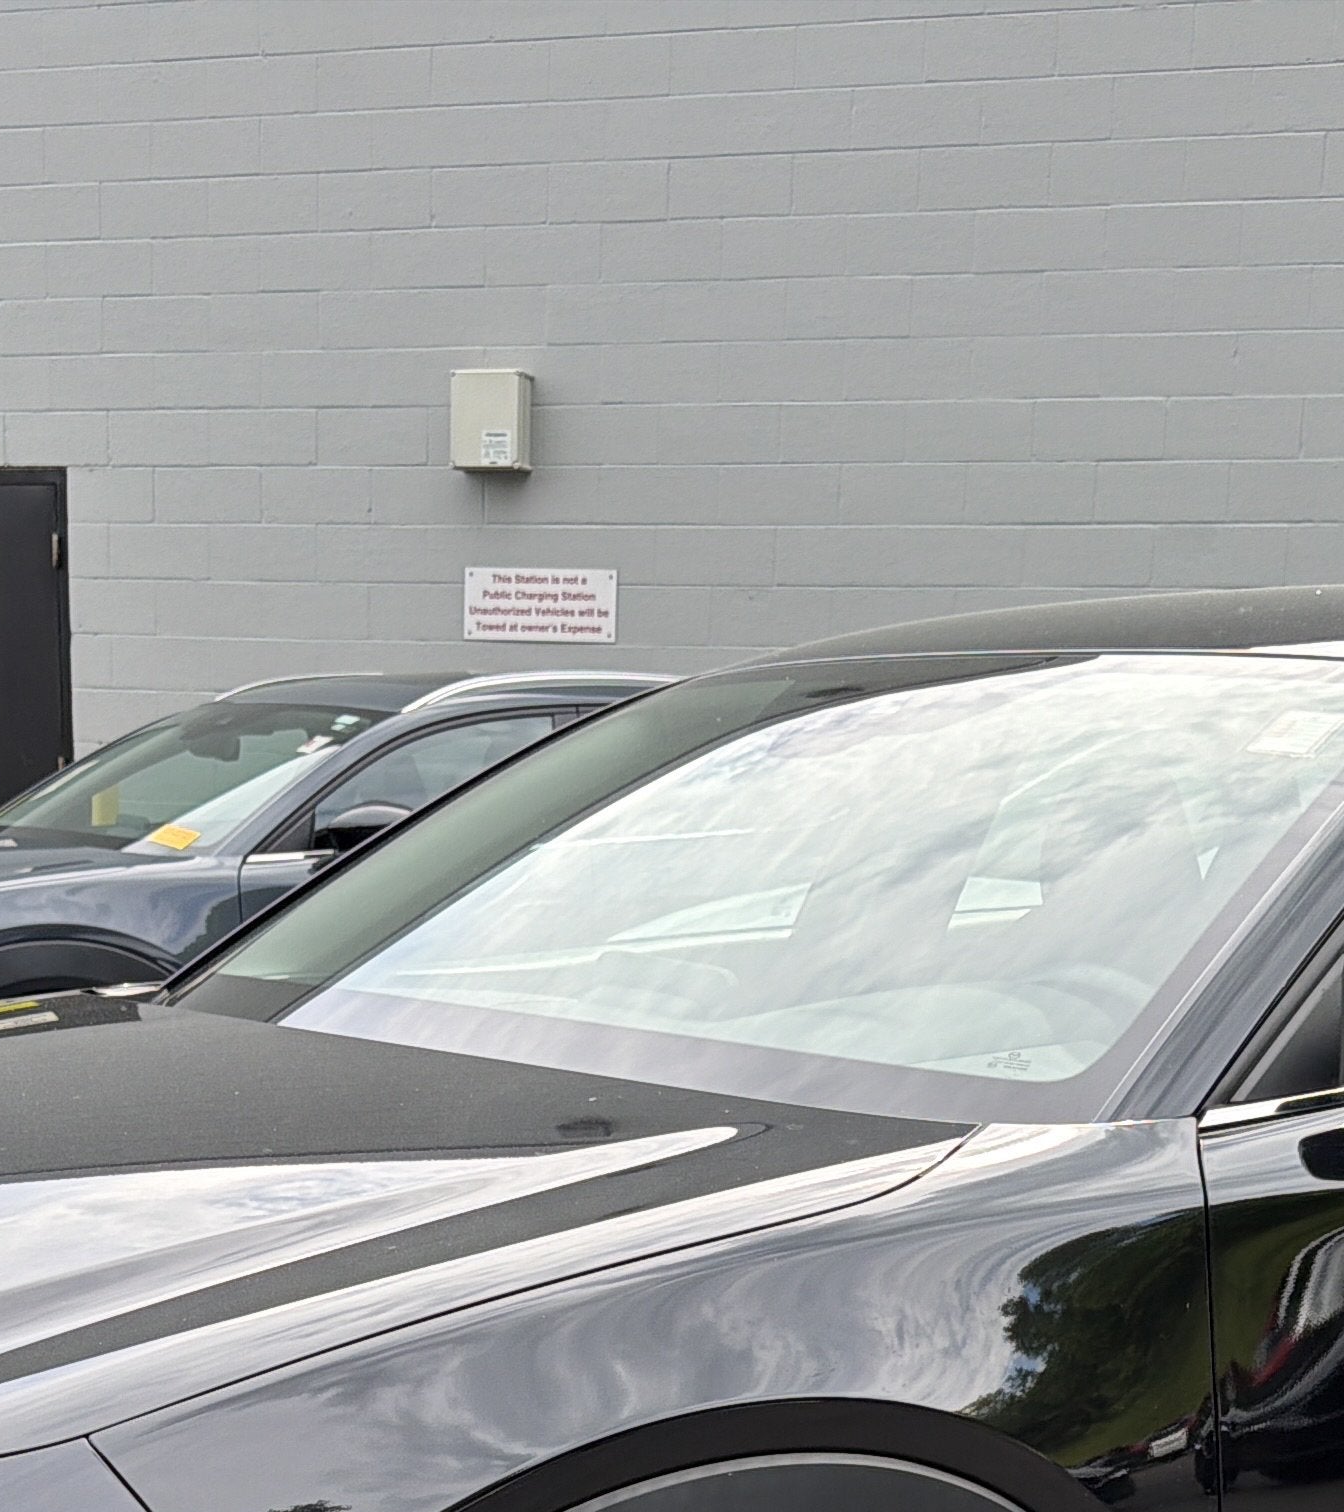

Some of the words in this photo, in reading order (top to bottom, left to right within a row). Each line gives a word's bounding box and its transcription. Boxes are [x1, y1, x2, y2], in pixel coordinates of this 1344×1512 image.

[492, 574, 512, 584] This
[515, 575, 549, 584] Station
[551, 575, 560, 584] is
[563, 576, 579, 585] not
[482, 590, 512, 600] Public
[514, 591, 558, 603] Charging
[561, 592, 596, 601] Station
[469, 606, 532, 617] Unauthorized
[534, 607, 575, 617] Vehicles
[578, 607, 595, 617] will
[597, 608, 610, 618] be
[476, 622, 506, 632] Towed
[509, 623, 518, 632] at
[560, 624, 602, 635] Expense
